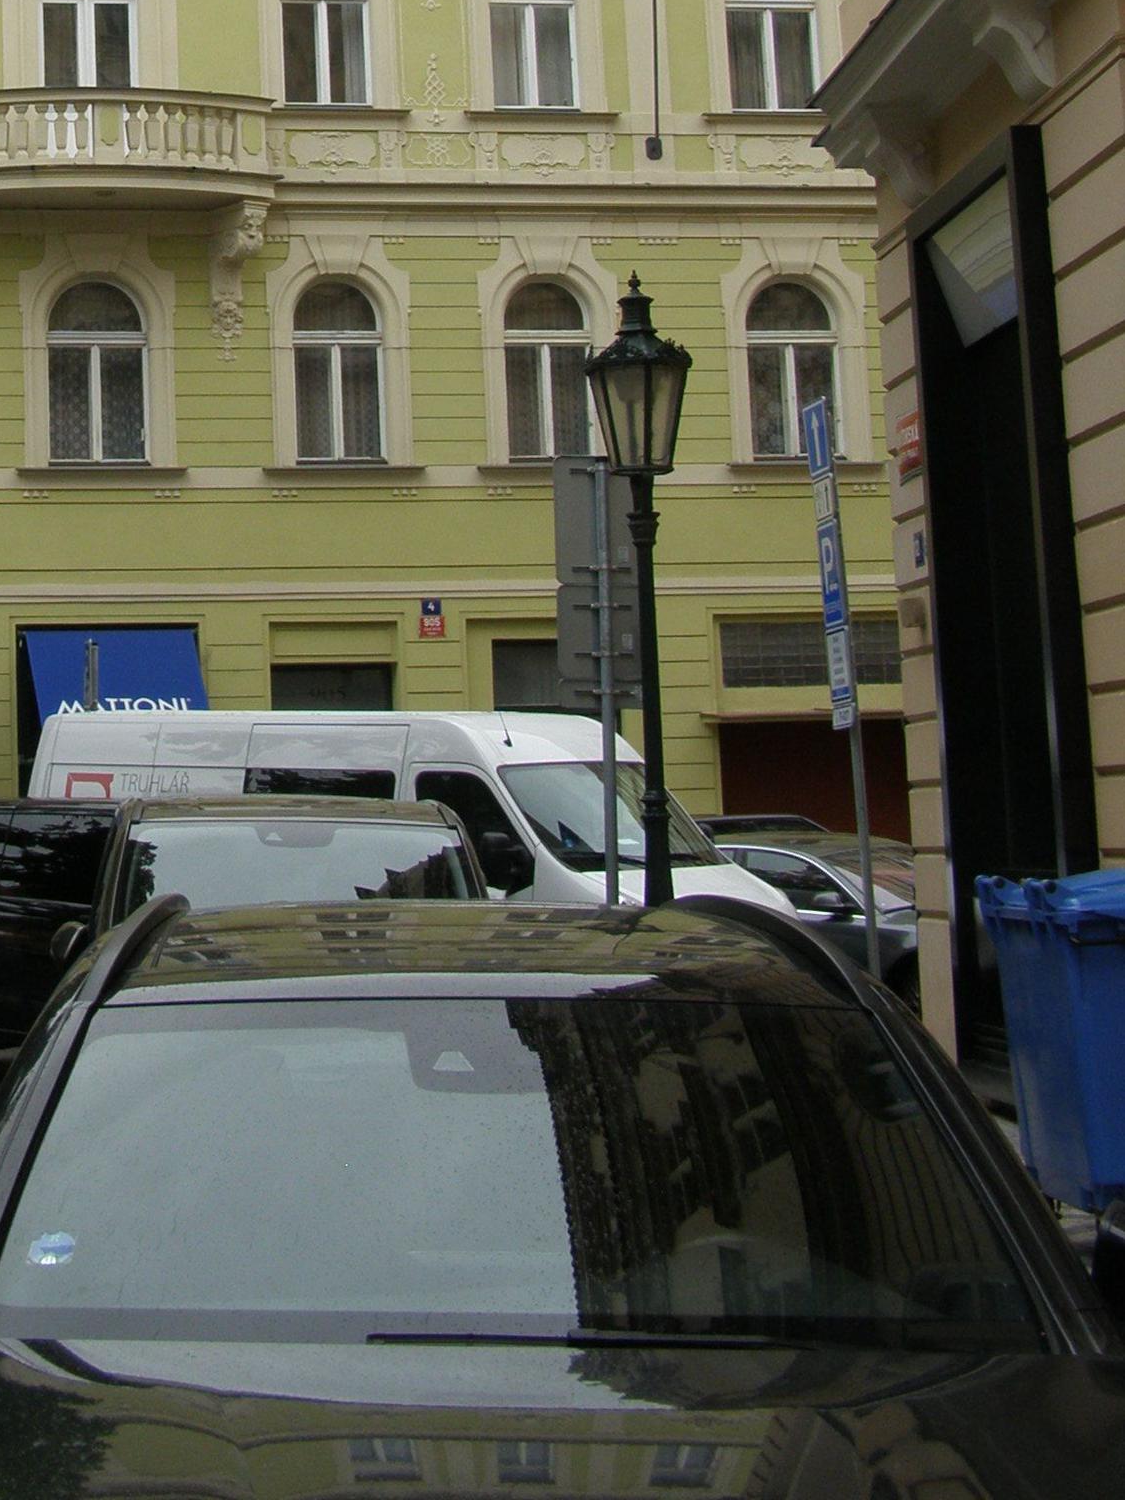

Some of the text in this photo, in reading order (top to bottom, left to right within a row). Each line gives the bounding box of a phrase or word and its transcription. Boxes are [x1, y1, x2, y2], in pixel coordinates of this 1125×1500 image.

[821, 537, 833, 595] P
[427, 601, 435, 614] 4
[121, 771, 190, 794] TRUHLÁŘ
